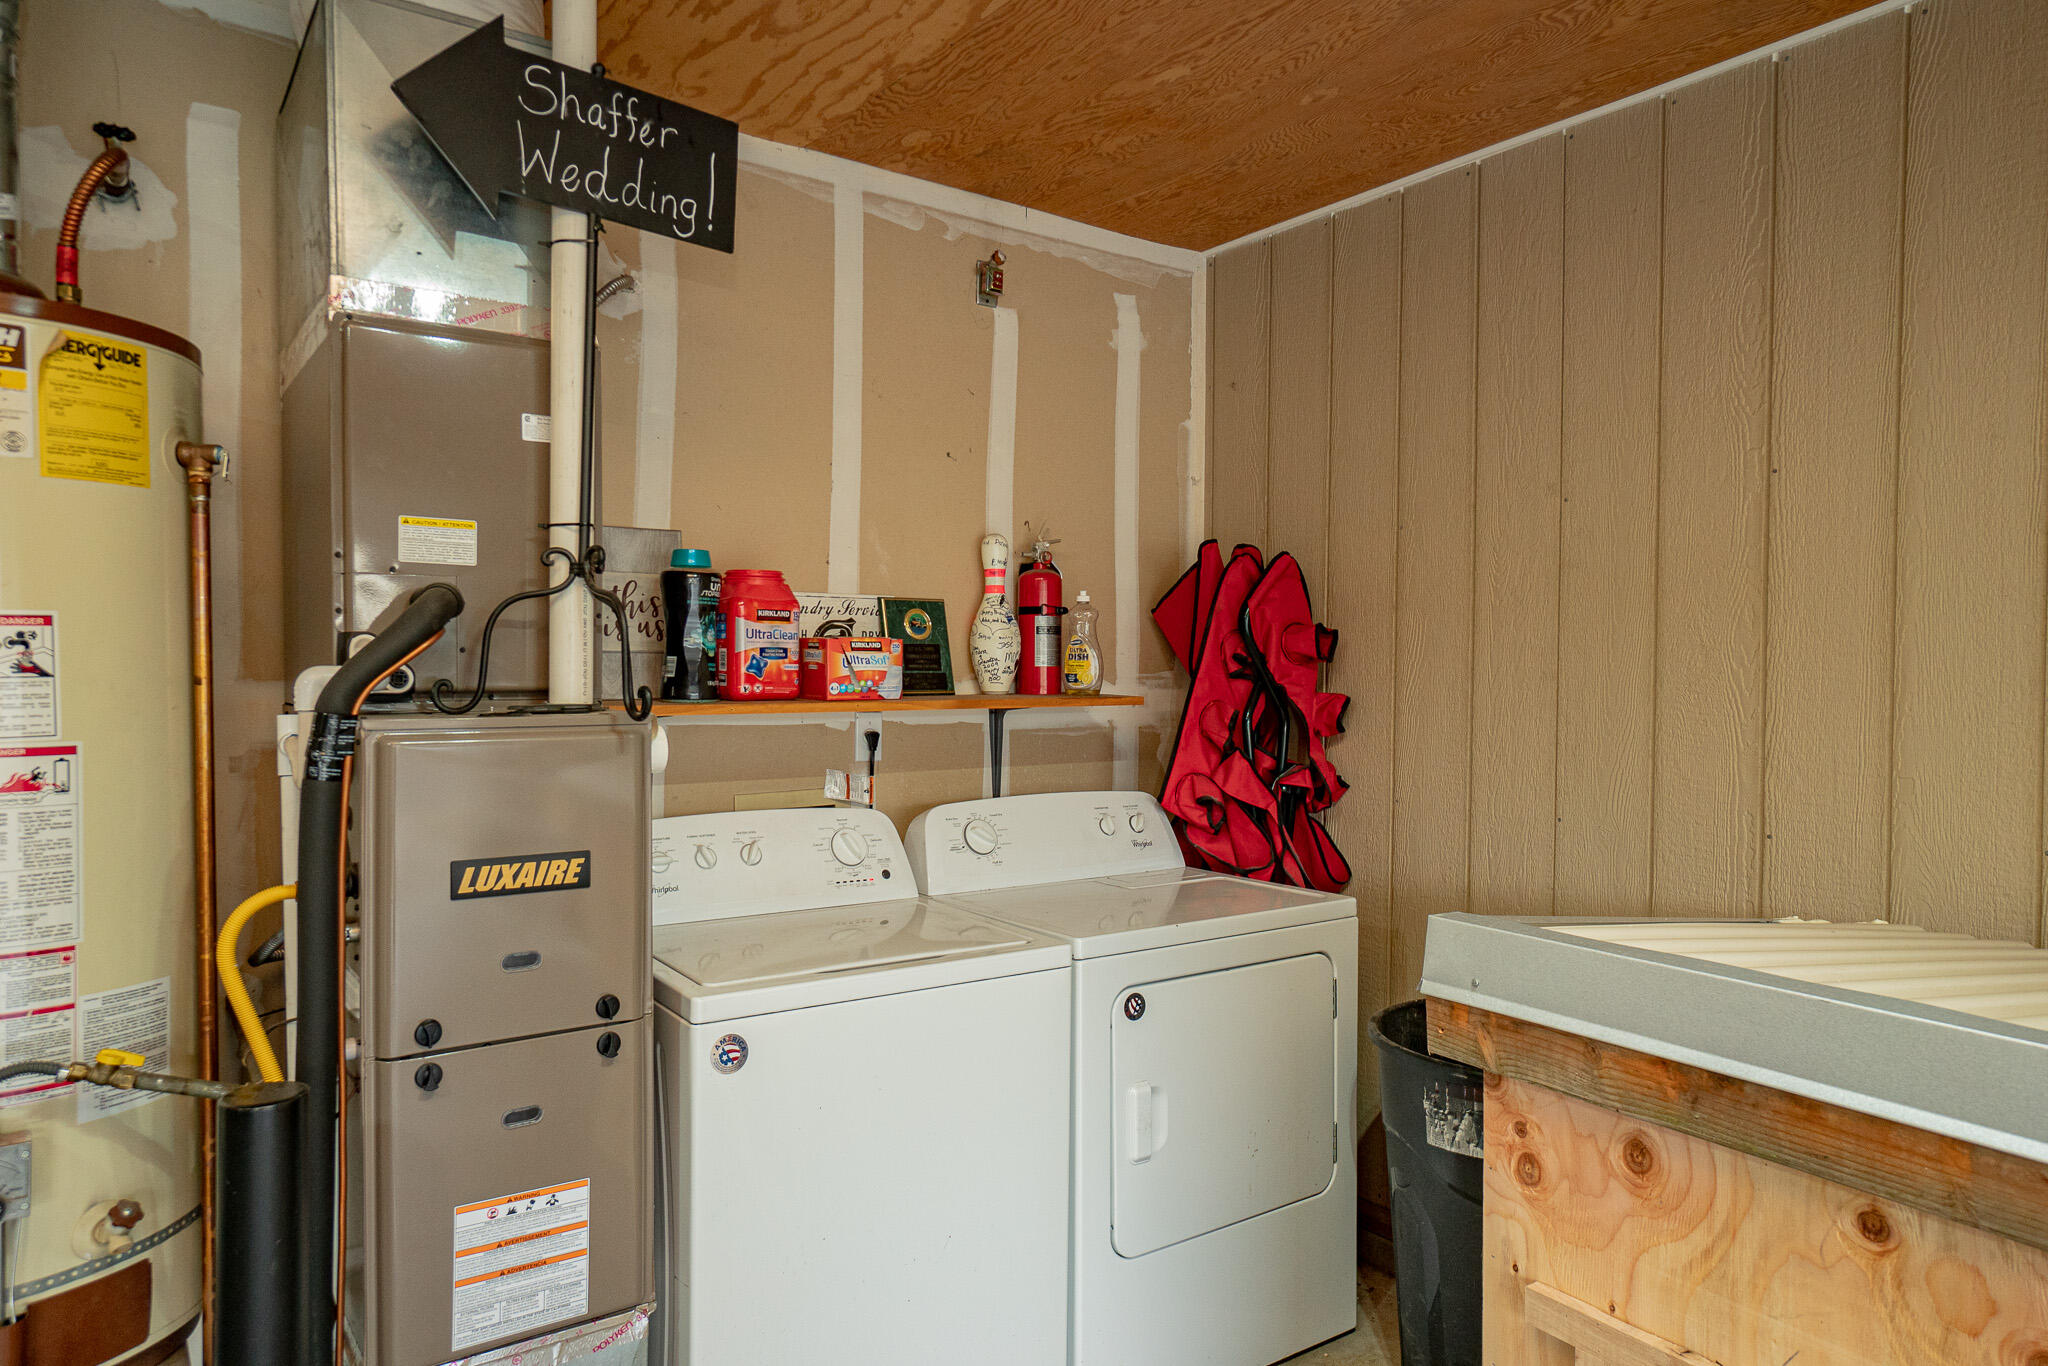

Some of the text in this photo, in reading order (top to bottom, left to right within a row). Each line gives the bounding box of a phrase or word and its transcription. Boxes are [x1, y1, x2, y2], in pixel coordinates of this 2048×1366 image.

[518, 64, 678, 148] Shaffer
[517, 119, 716, 238] Wedding!
[758, 609, 790, 618] KIRKLAND
[745, 627, 799, 641] UltraClean
[1068, 653, 1089, 661] DISH
[457, 857, 586, 894] LUXAIRE
[651, 884, 680, 895] hirlpool
[715, 1035, 747, 1052] AMERICA
[513, 1191, 541, 1201] WARNING
[503, 1230, 551, 1247] AVERTISSEMENT
[506, 1260, 548, 1274] ADVERTENCIA
[592, 1320, 634, 1353] POLYKEN
